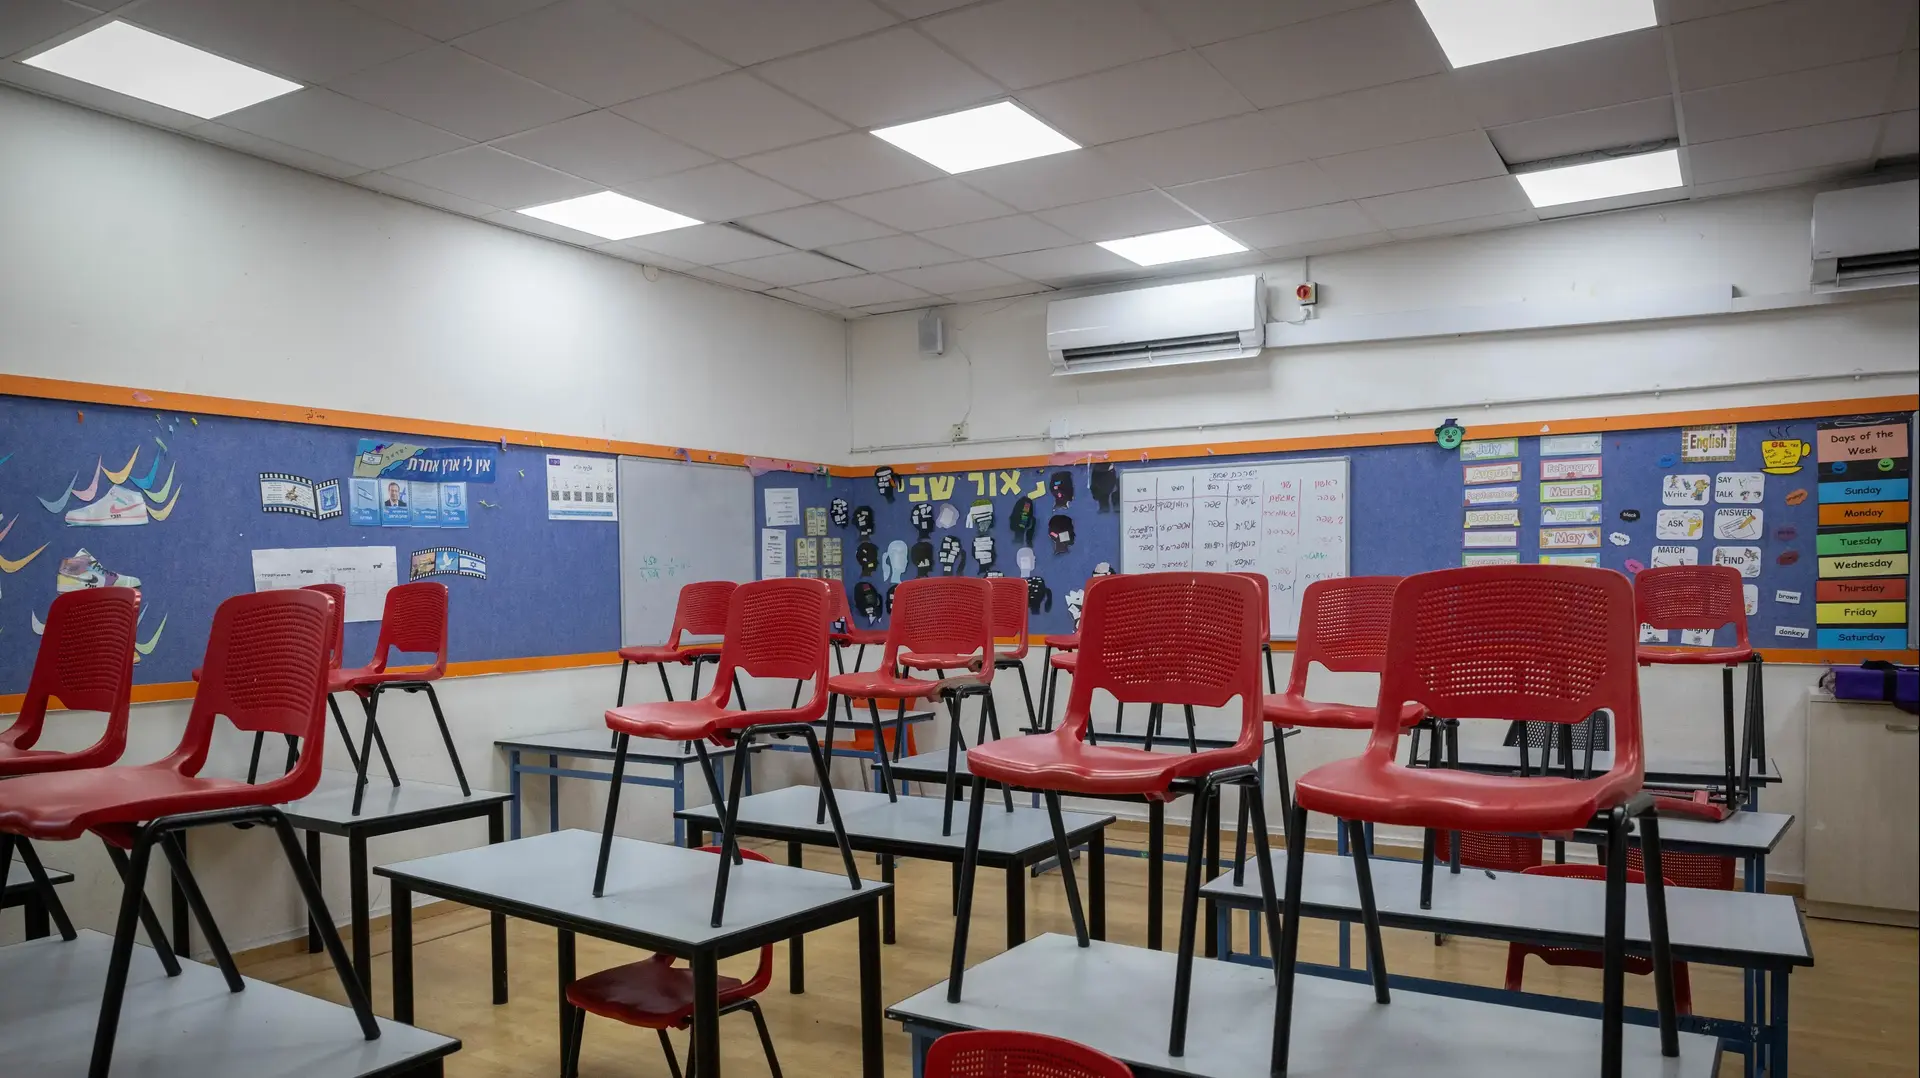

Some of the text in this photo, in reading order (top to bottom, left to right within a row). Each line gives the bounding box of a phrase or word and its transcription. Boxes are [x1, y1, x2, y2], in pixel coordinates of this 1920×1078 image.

[1830, 430, 1894, 444] Days of the
[1689, 433, 1727, 453] English
[1476, 443, 1502, 455] July
[1847, 445, 1878, 456] Week
[406, 455, 491, 475] אין לי ארץ אחרת
[1547, 463, 1596, 474] February
[1472, 467, 1512, 480] August
[1549, 485, 1591, 498] March
[1663, 490, 1688, 498] Write
[1715, 490, 1734, 498] TALK
[1844, 486, 1882, 495] Sunday
[1469, 512, 1515, 523] October
[1555, 510, 1586, 521] April
[1717, 509, 1753, 517] ANSWER
[1844, 508, 1884, 518] Monday
[1554, 531, 1586, 545] May
[1839, 536, 1883, 546] Tuesday
[1657, 546, 1686, 554] MATCH
[1723, 556, 1745, 565] FIND
[1833, 559, 1894, 570] Wednesday
[1837, 584, 1886, 593] Thursday
[1778, 593, 1799, 601] brown
[1844, 608, 1878, 618] Friday
[1778, 627, 1805, 638] donkey
[1838, 633, 1886, 643] Saturday
